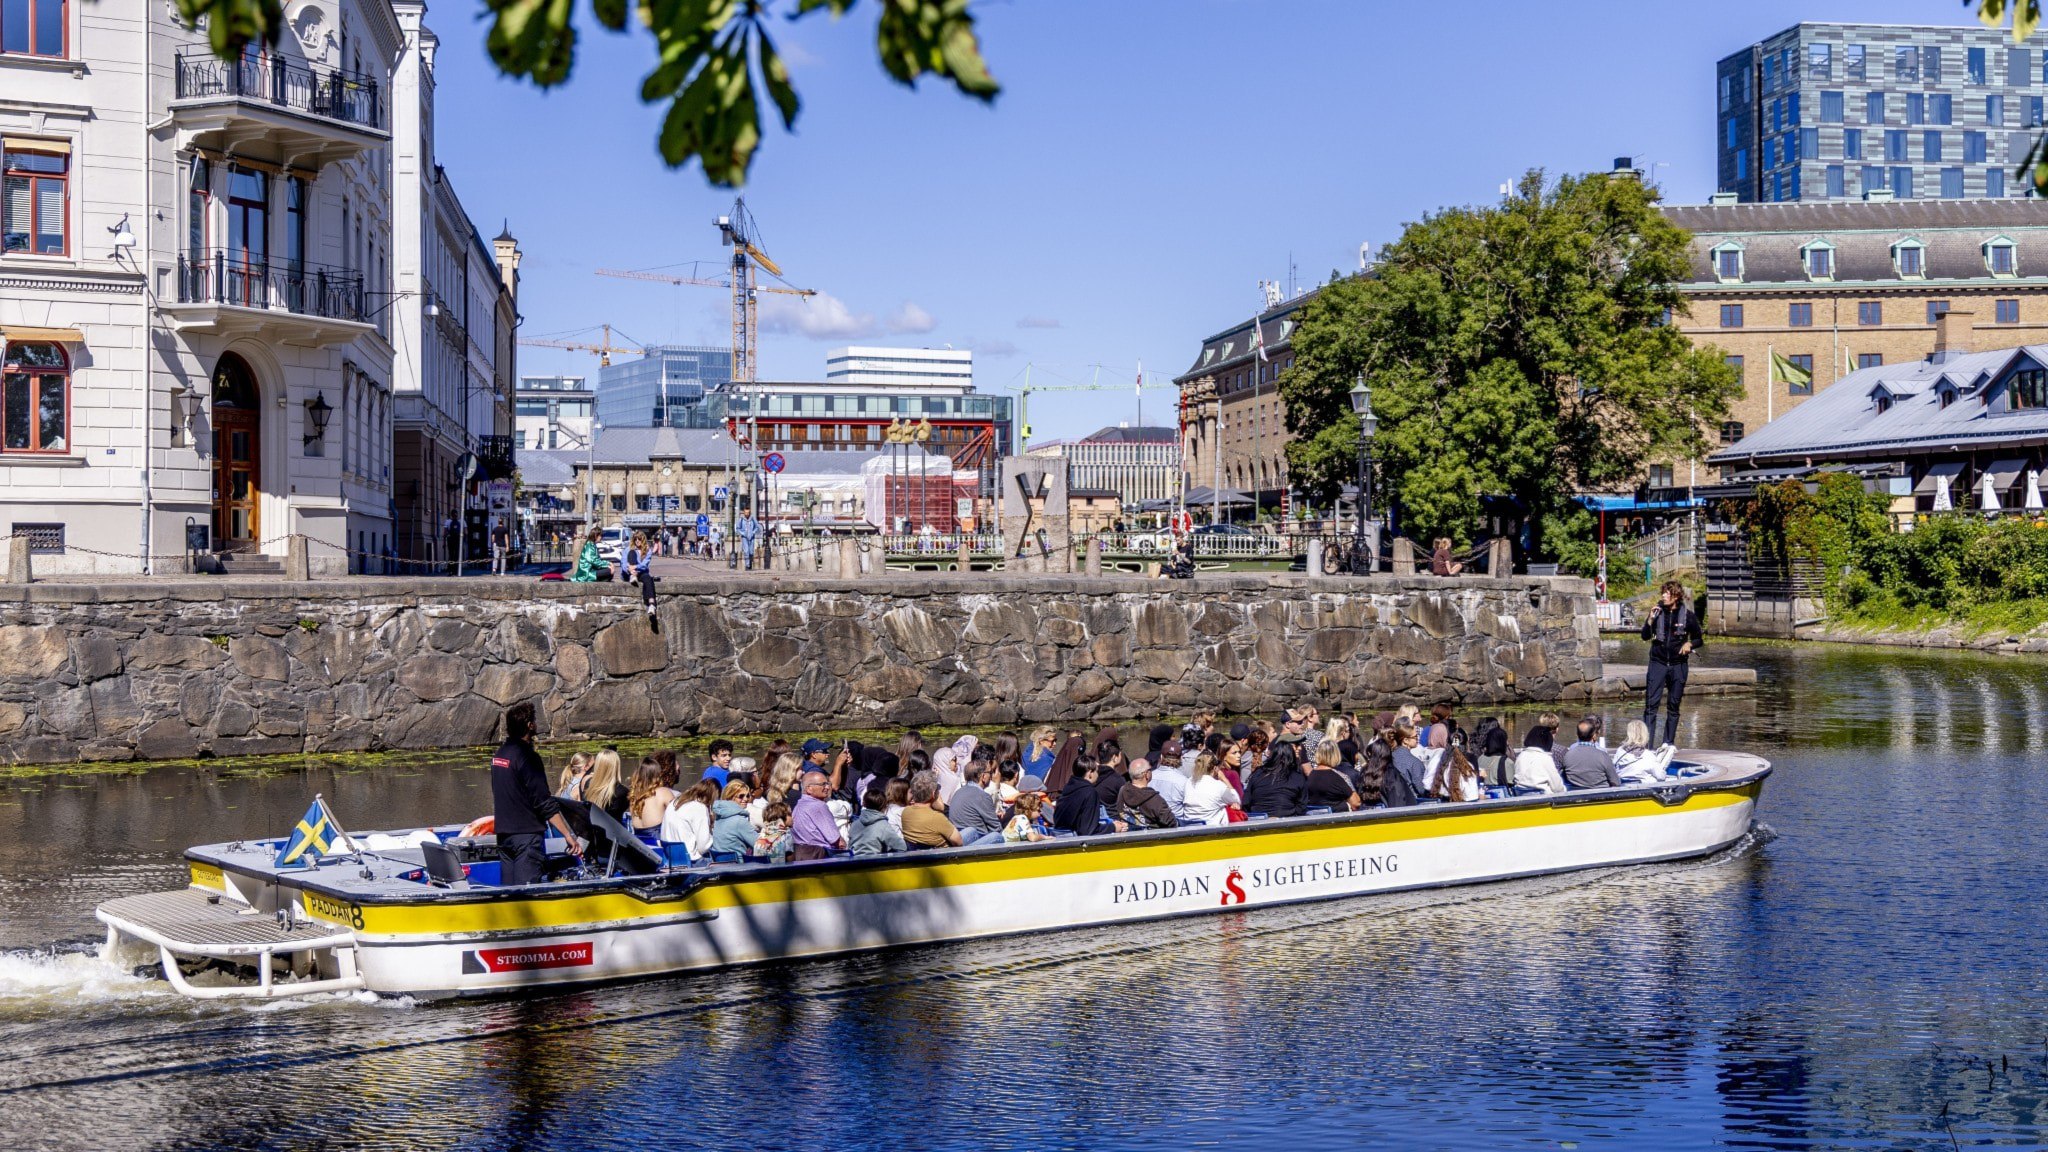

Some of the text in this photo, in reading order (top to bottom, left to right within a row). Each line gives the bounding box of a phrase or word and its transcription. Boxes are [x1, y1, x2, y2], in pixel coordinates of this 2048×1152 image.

[219, 374, 230, 388] 7A
[1112, 854, 1399, 904] PADDAN SIGHTSEEING
[310, 896, 365, 931] PADDAN 8
[497, 949, 587, 966] STROMMA.COM
